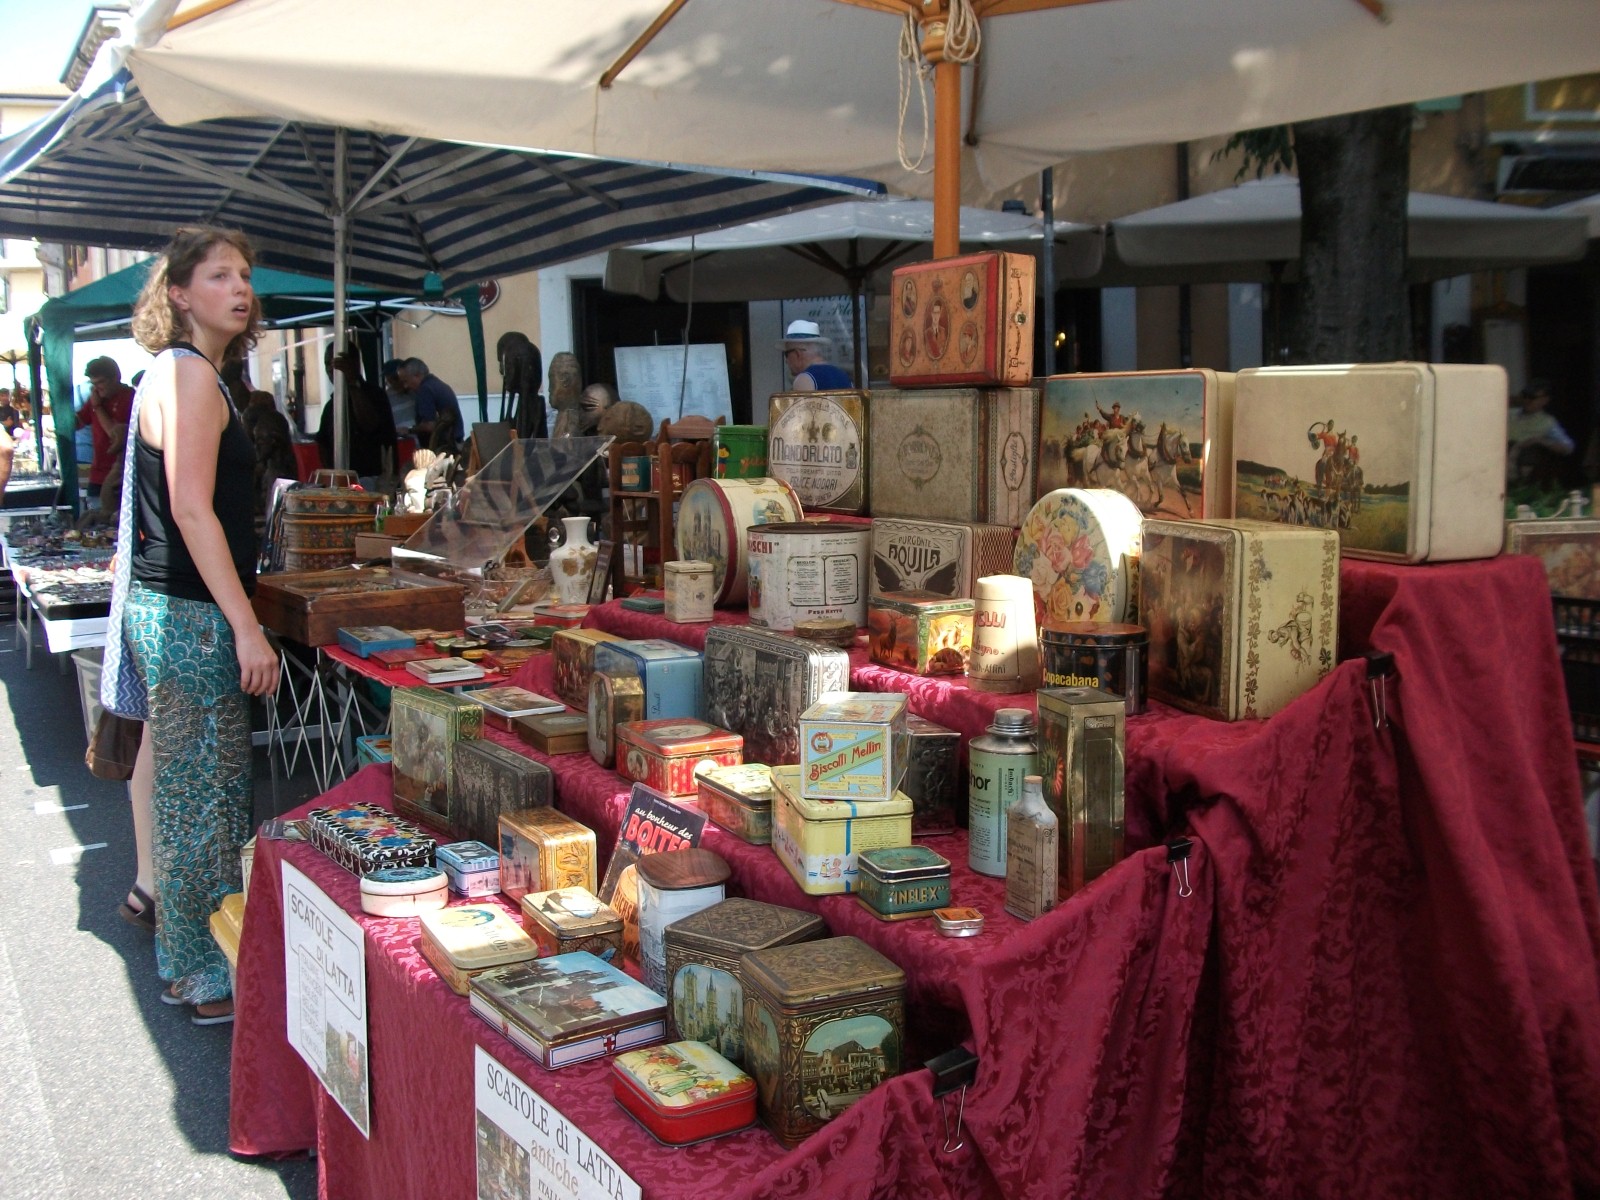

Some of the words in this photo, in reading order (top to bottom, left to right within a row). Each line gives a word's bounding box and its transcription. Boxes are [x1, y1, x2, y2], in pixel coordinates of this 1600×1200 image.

[888, 544, 941, 576] AQUILA
[1042, 669, 1099, 688] Copacabana
[809, 753, 847, 781] Biscotti
[851, 741, 881, 764] Mellin
[634, 807, 646, 819] au
[646, 809, 678, 832] bonheur
[678, 827, 694, 840] des
[291, 893, 334, 951] SCATOLE
[316, 945, 324, 964] DI
[324, 953, 356, 1002] LATTA
[486, 1062, 550, 1137] SCATOLE
[556, 1119, 570, 1155] di
[576, 1136, 624, 1200] LATTA
[531, 1139, 580, 1196] antiche
[538, 1178, 562, 1200] ITALI
